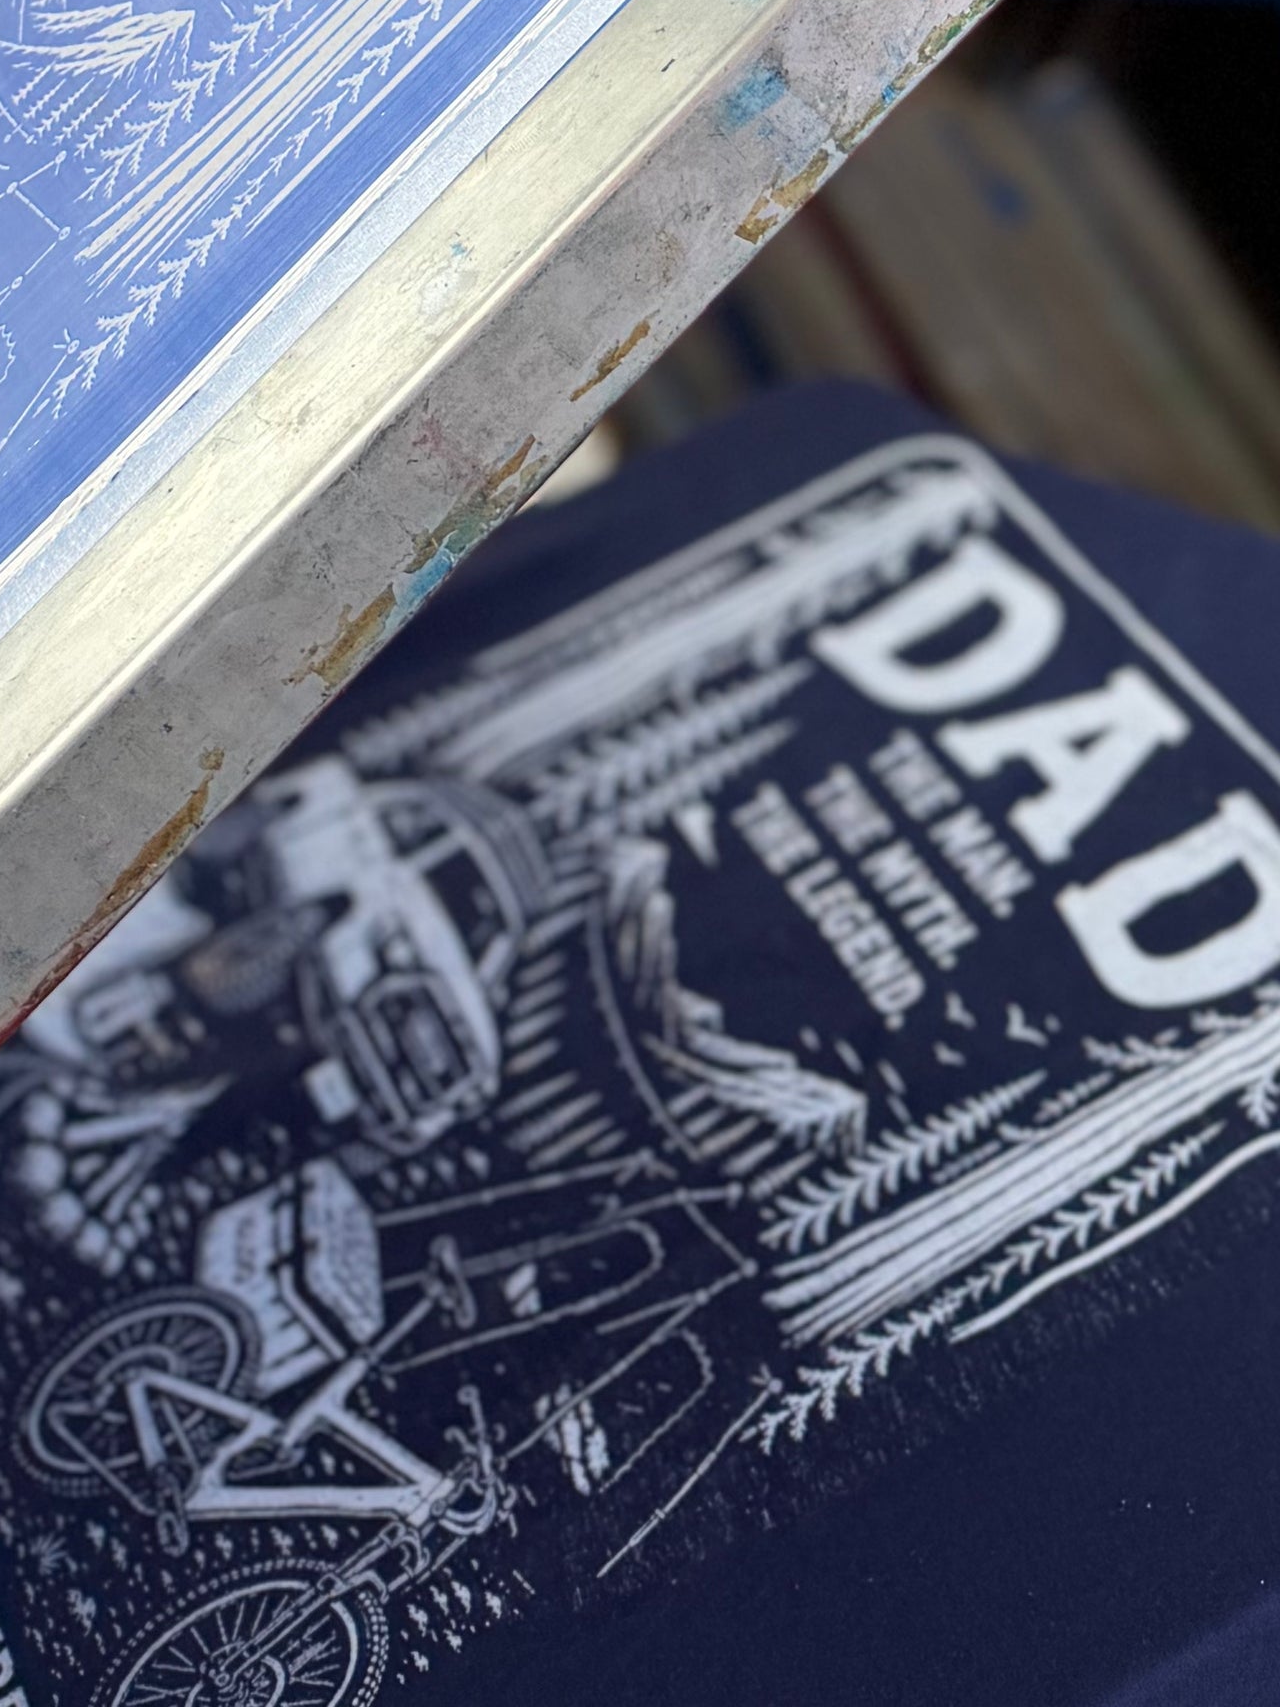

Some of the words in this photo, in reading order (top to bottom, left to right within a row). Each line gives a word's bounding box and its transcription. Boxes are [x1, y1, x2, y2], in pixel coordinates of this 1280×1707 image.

[729, 781, 821, 877] THE
[783, 857, 925, 1032] LEGEND.
[803, 762, 895, 856] THE
[857, 836, 979, 972] MYTH.
[869, 727, 962, 822] THE
[927, 803, 1035, 920] MAN.
